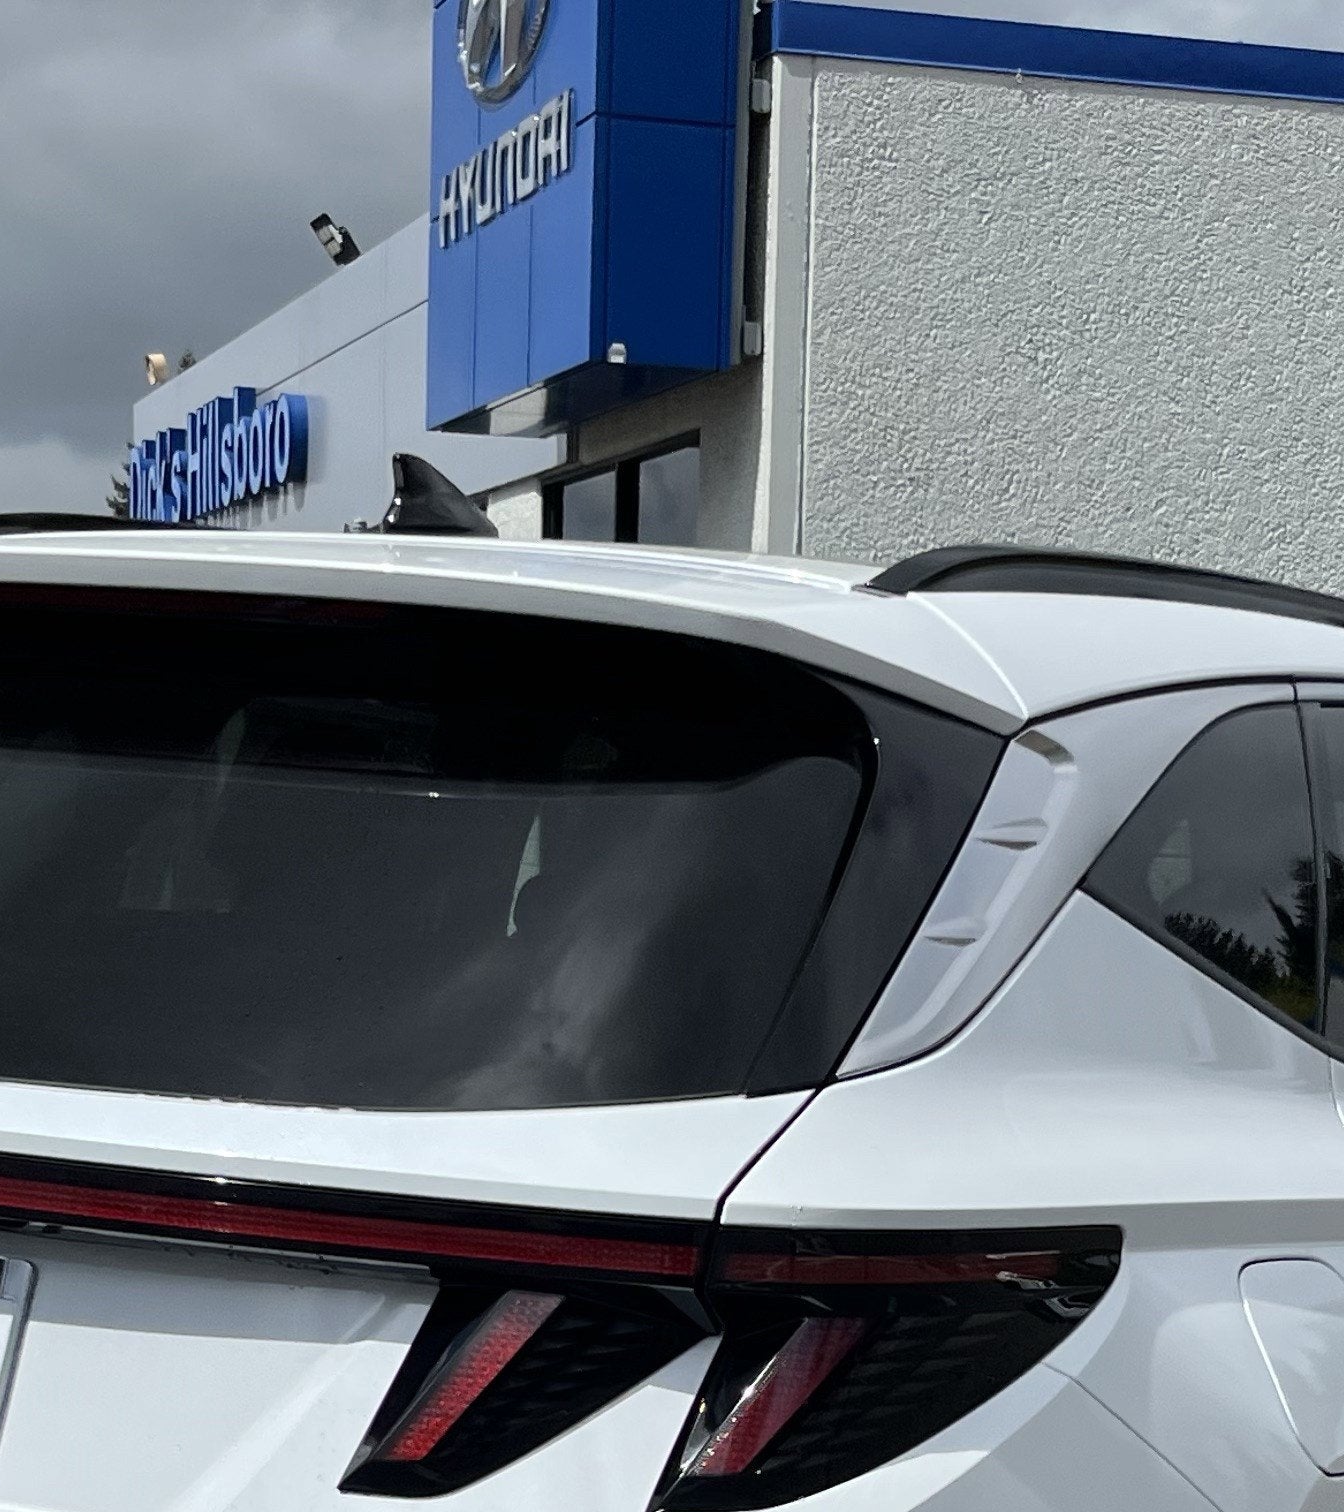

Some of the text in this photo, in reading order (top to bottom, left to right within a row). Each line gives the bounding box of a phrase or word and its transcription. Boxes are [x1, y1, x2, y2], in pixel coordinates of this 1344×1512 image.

[439, 88, 571, 249] HYUNDAI
[130, 387, 300, 523] Dick's Hillsboro
